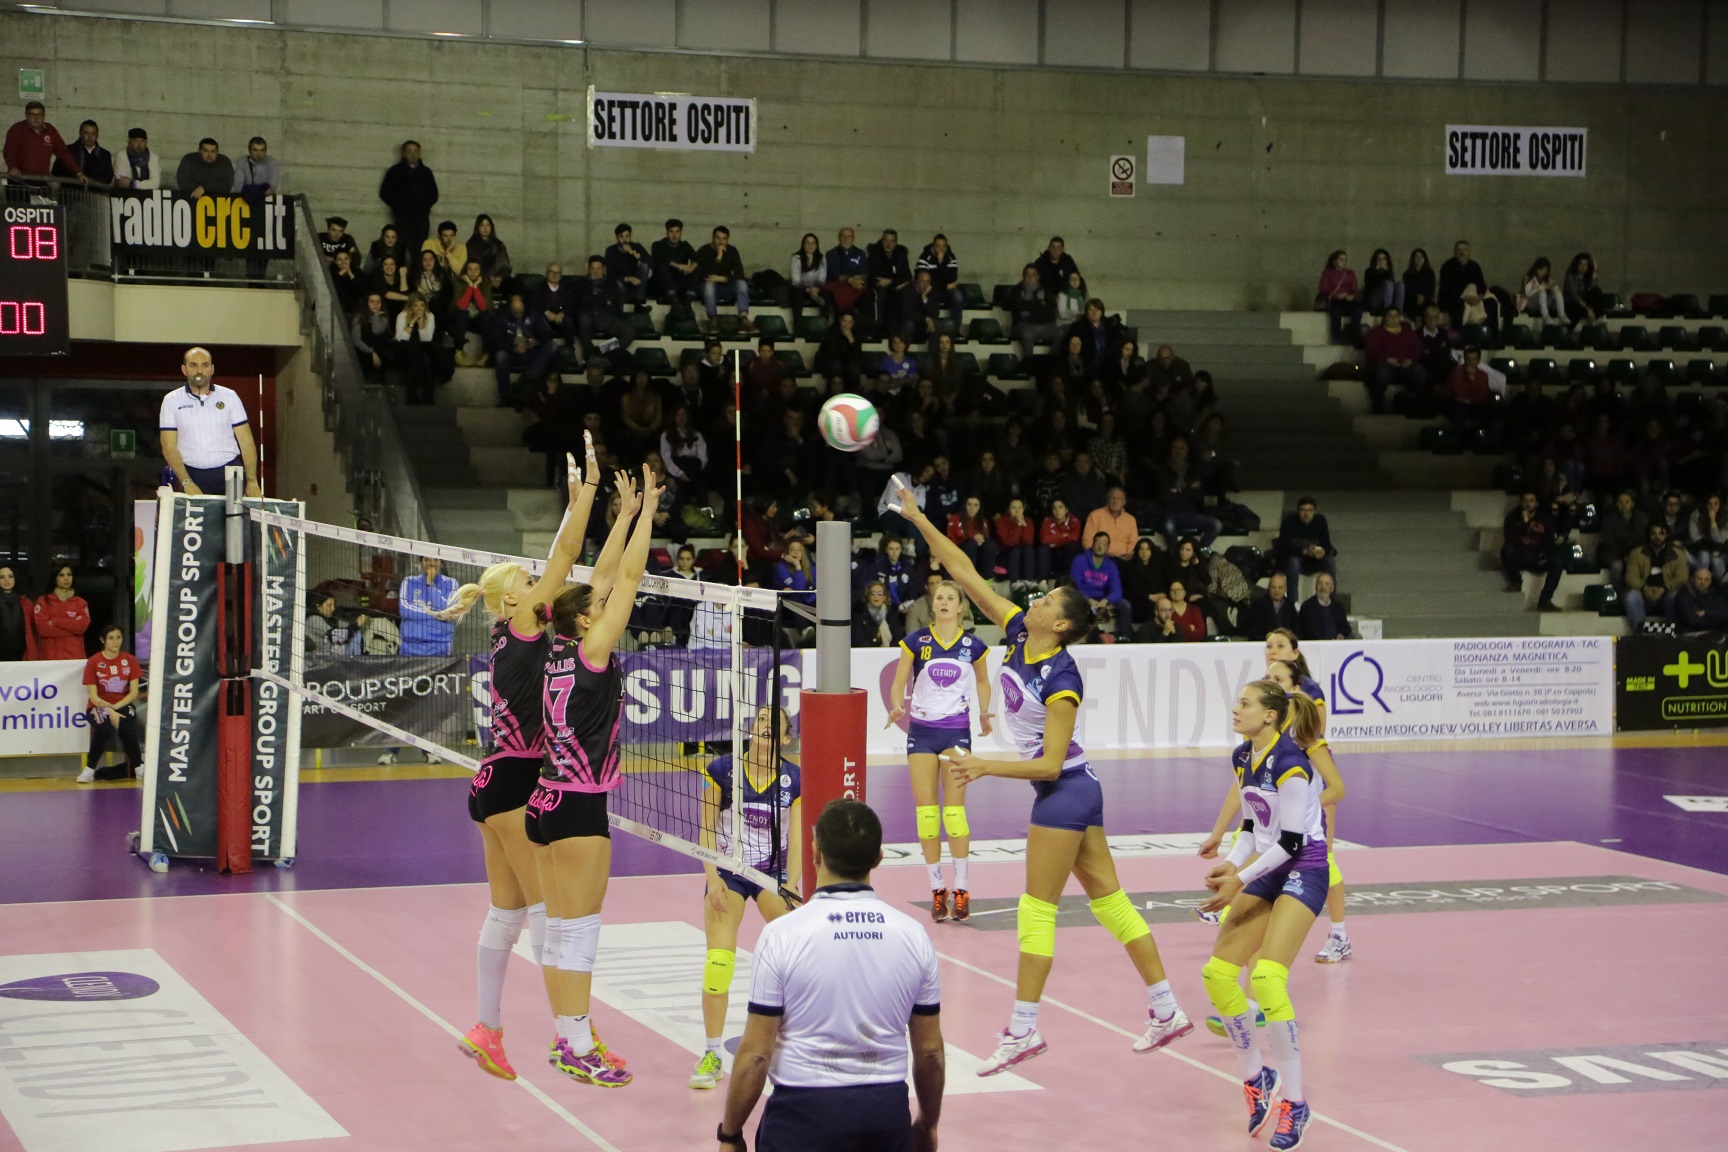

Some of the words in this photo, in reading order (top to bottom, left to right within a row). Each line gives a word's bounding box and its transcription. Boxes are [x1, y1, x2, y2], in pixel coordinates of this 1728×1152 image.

[594, 98, 677, 142] SETTORE
[687, 103, 750, 145] OSPITI
[1448, 130, 1521, 169] SETTORE
[1528, 132, 1584, 171] OSPITI
[4, 207, 54, 224] OSPITI
[10, 226, 58, 260] 08
[181, 501, 205, 582] SPORT
[175, 587, 199, 677] GROUP
[265, 575, 286, 674] MASTER
[920, 645, 933, 661] 18
[1454, 641, 1513, 651] RADIOLOGIA
[1521, 640, 1576, 649] ECOGRAFIA
[1581, 639, 1600, 648] TAC
[1454, 653, 1509, 663] RISONANZA
[1512, 652, 1569, 661] MAGNETICA
[932, 668, 958, 679] CLENDY
[1406, 675, 1443, 683] CENTRO
[384, 673, 467, 700] SPORT
[1400, 693, 1443, 702] LIGUORI
[350, 702, 387, 713] SPORT
[1668, 701, 1727, 713] NUTRITION
[168, 682, 194, 783] MASTER
[255, 680, 279, 770] GROUP
[1331, 726, 1382, 737] PARTNER
[1384, 724, 1429, 736] MEDICO
[1430, 723, 1457, 735] NEW
[1460, 721, 1501, 733] VOLLEY
[1504, 720, 1553, 732] LIBERTAS
[1555, 719, 1598, 731] AVERSA
[250, 774, 274, 856] SPORT
[845, 911, 886, 924] errea
[833, 931, 883, 941] AUTUORI
